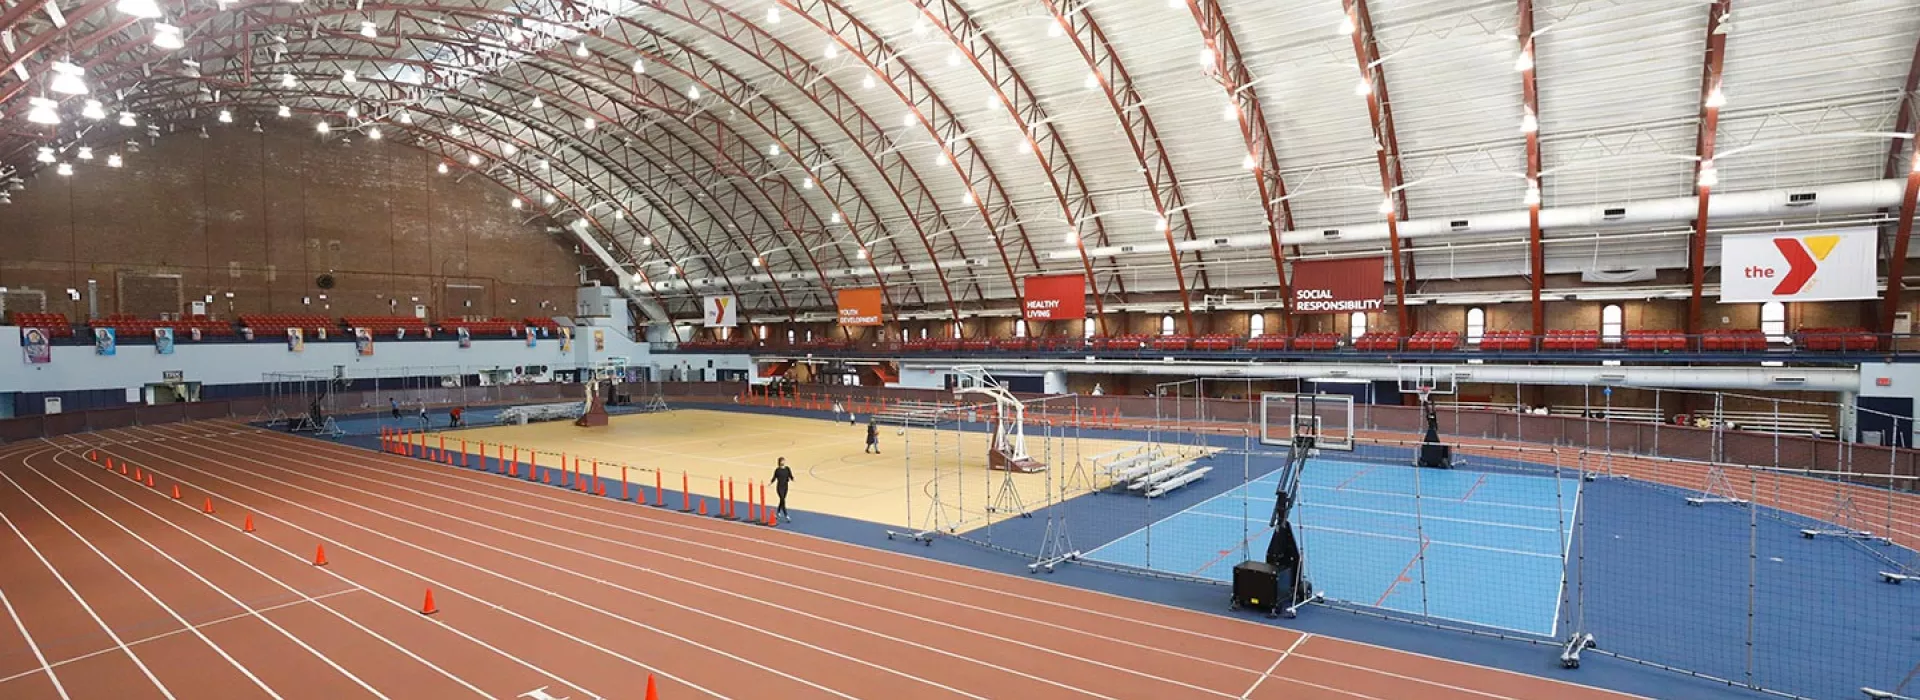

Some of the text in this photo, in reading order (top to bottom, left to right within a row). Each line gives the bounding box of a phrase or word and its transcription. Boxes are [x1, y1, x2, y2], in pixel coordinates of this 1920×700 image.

[1744, 265, 1775, 279] the
[1296, 289, 1333, 299] SOCIAL
[1026, 300, 1060, 308] HEALTHY
[1296, 299, 1382, 311] RESPONSIBILITY
[1026, 309, 1051, 318] LIVING
[839, 316, 878, 324] DEVELOPMENT
